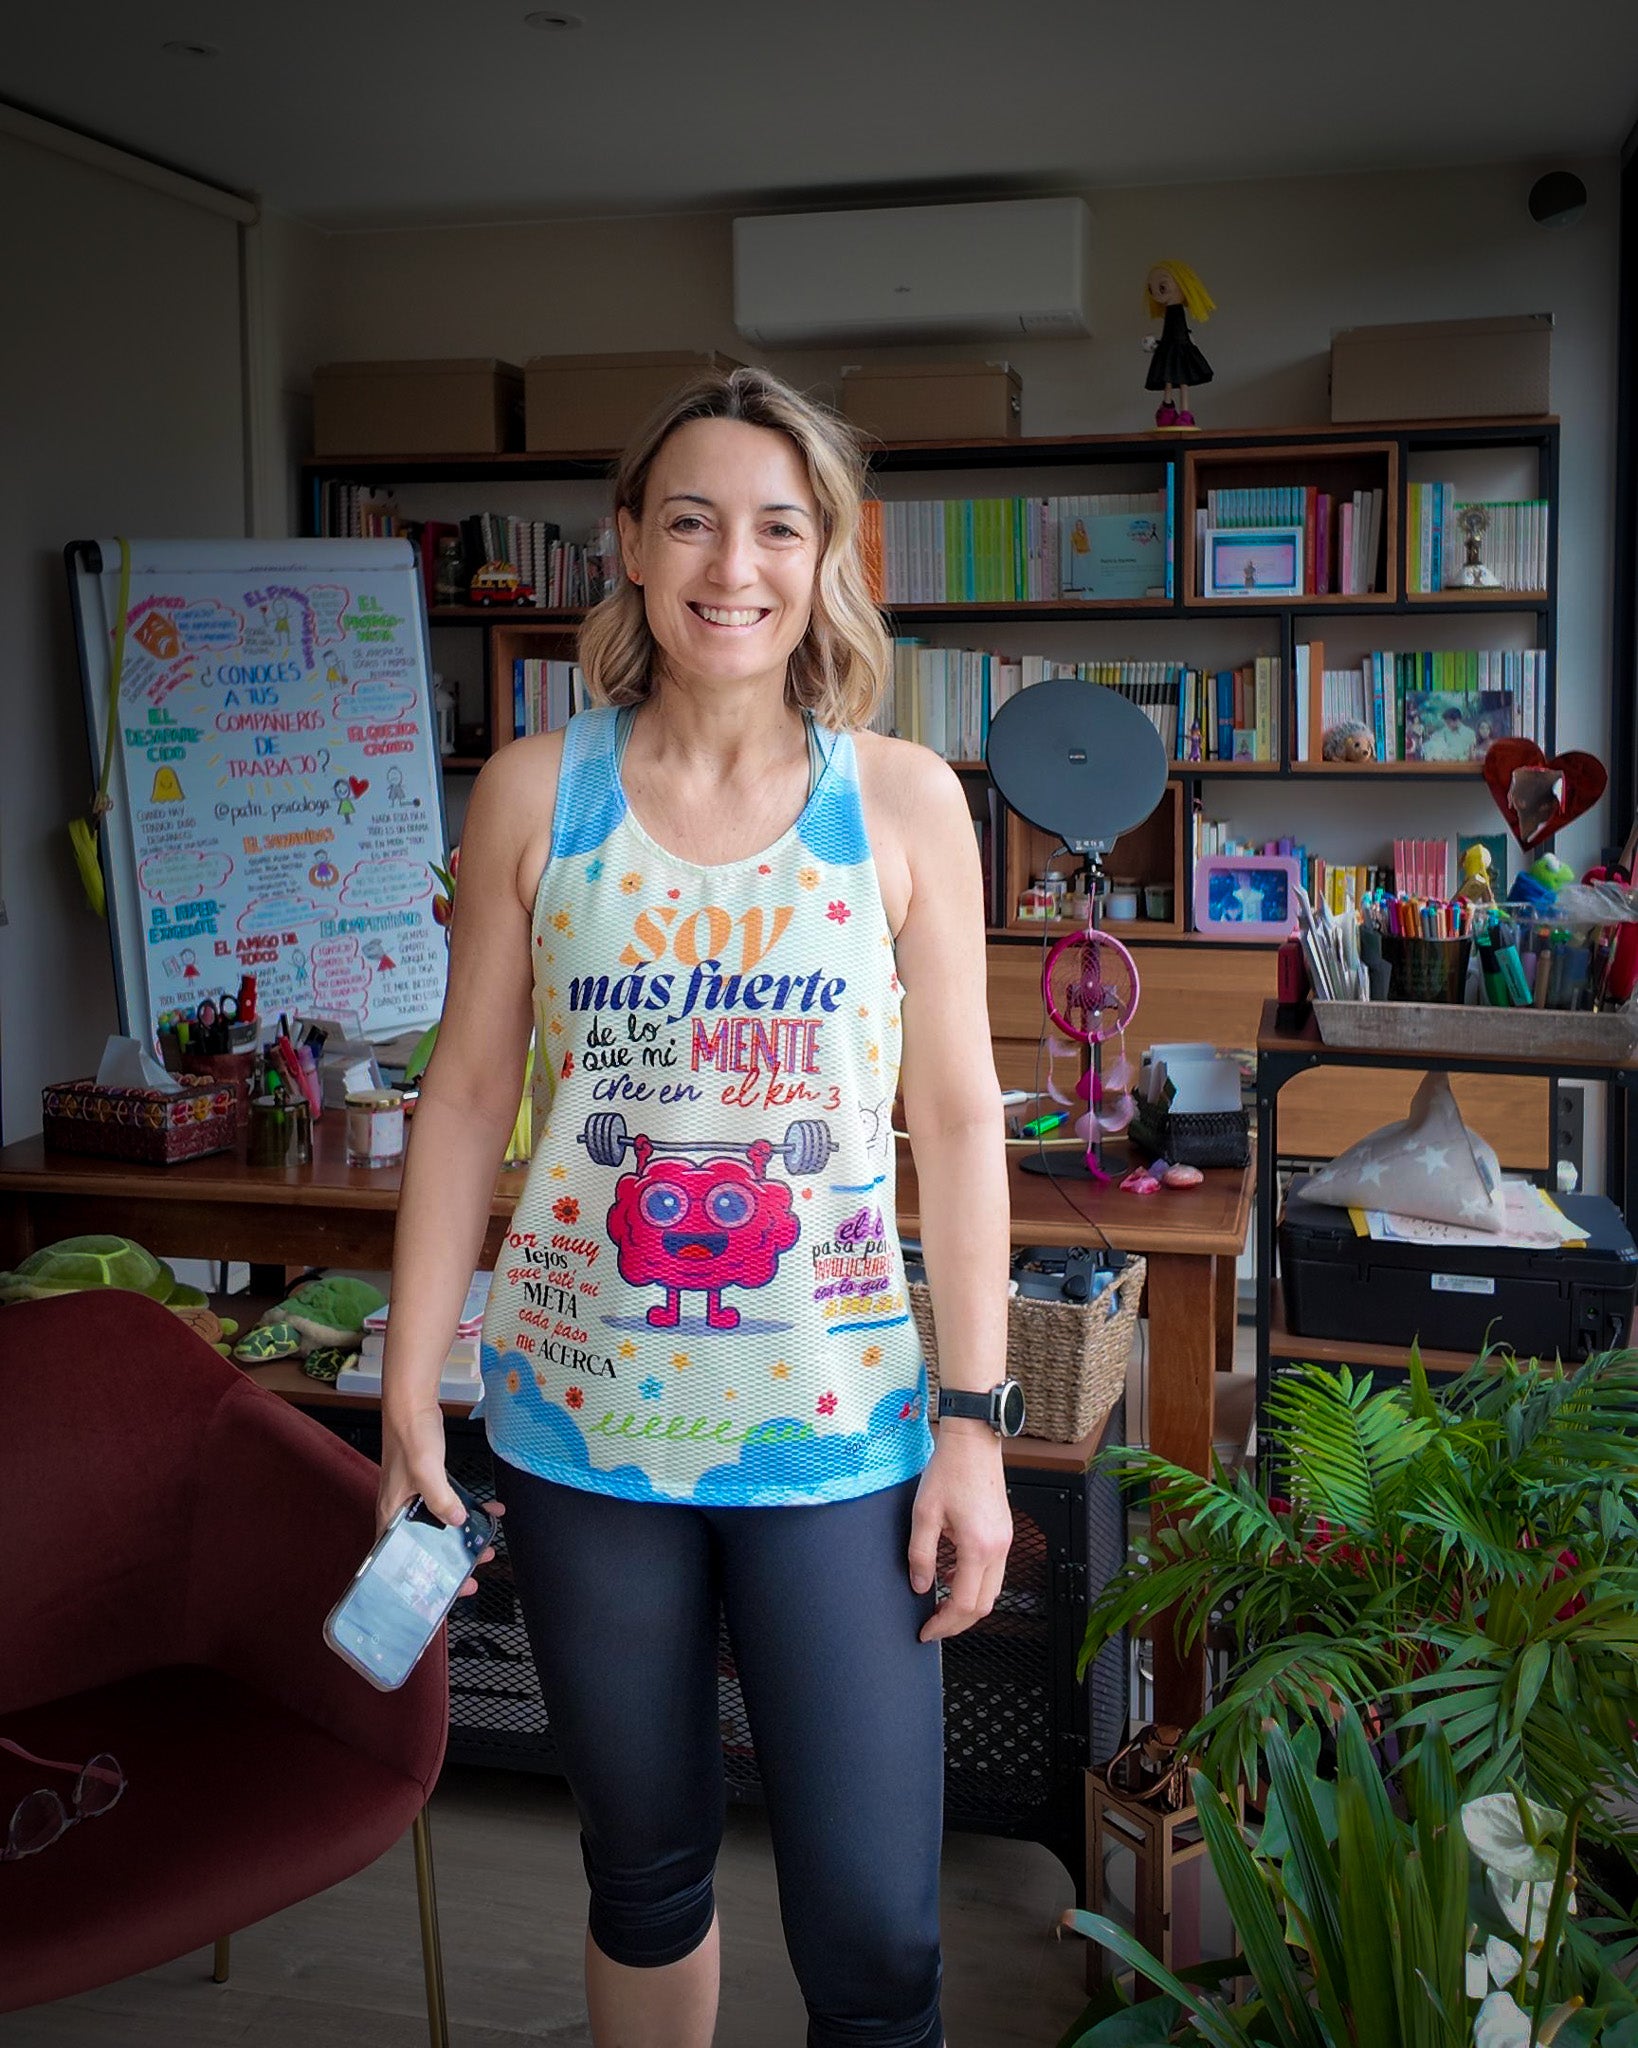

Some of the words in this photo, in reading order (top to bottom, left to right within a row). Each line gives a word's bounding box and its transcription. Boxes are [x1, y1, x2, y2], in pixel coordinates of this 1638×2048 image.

[201, 661, 301, 688] ¿CONOCES
[224, 690, 240, 707] A
[248, 686, 279, 706] TUS
[147, 708, 178, 726] EL
[215, 708, 326, 733] COMPAÑEROS
[254, 735, 282, 756] DE
[226, 748, 330, 779] TRABAJO?
[151, 907, 171, 926] EL
[214, 940, 231, 957] EL
[236, 934, 279, 952] AMIGO
[569, 960, 675, 1012] más
[666, 958, 847, 1025] fuerte
[587, 1015, 617, 1049] de
[627, 1013, 662, 1043] lo
[690, 1016, 824, 1075] MENTE
[592, 1073, 656, 1102] cree
[659, 1083, 703, 1105] en
[721, 1066, 764, 1108] el
[763, 1061, 821, 1110] km
[822, 1086, 842, 1111] 3
[840, 1211, 867, 1240] el
[524, 1245, 568, 1270] lejos
[551, 1232, 600, 1267] muy
[812, 1239, 856, 1268] pasa
[506, 1266, 541, 1285] que
[548, 1268, 577, 1290] esté
[579, 1280, 600, 1297] mi
[860, 1278, 890, 1298] que
[523, 1281, 578, 1319] META
[518, 1307, 549, 1330] cada
[551, 1319, 589, 1343] paso
[515, 1332, 537, 1353] me
[537, 1338, 617, 1379] ACERCA
